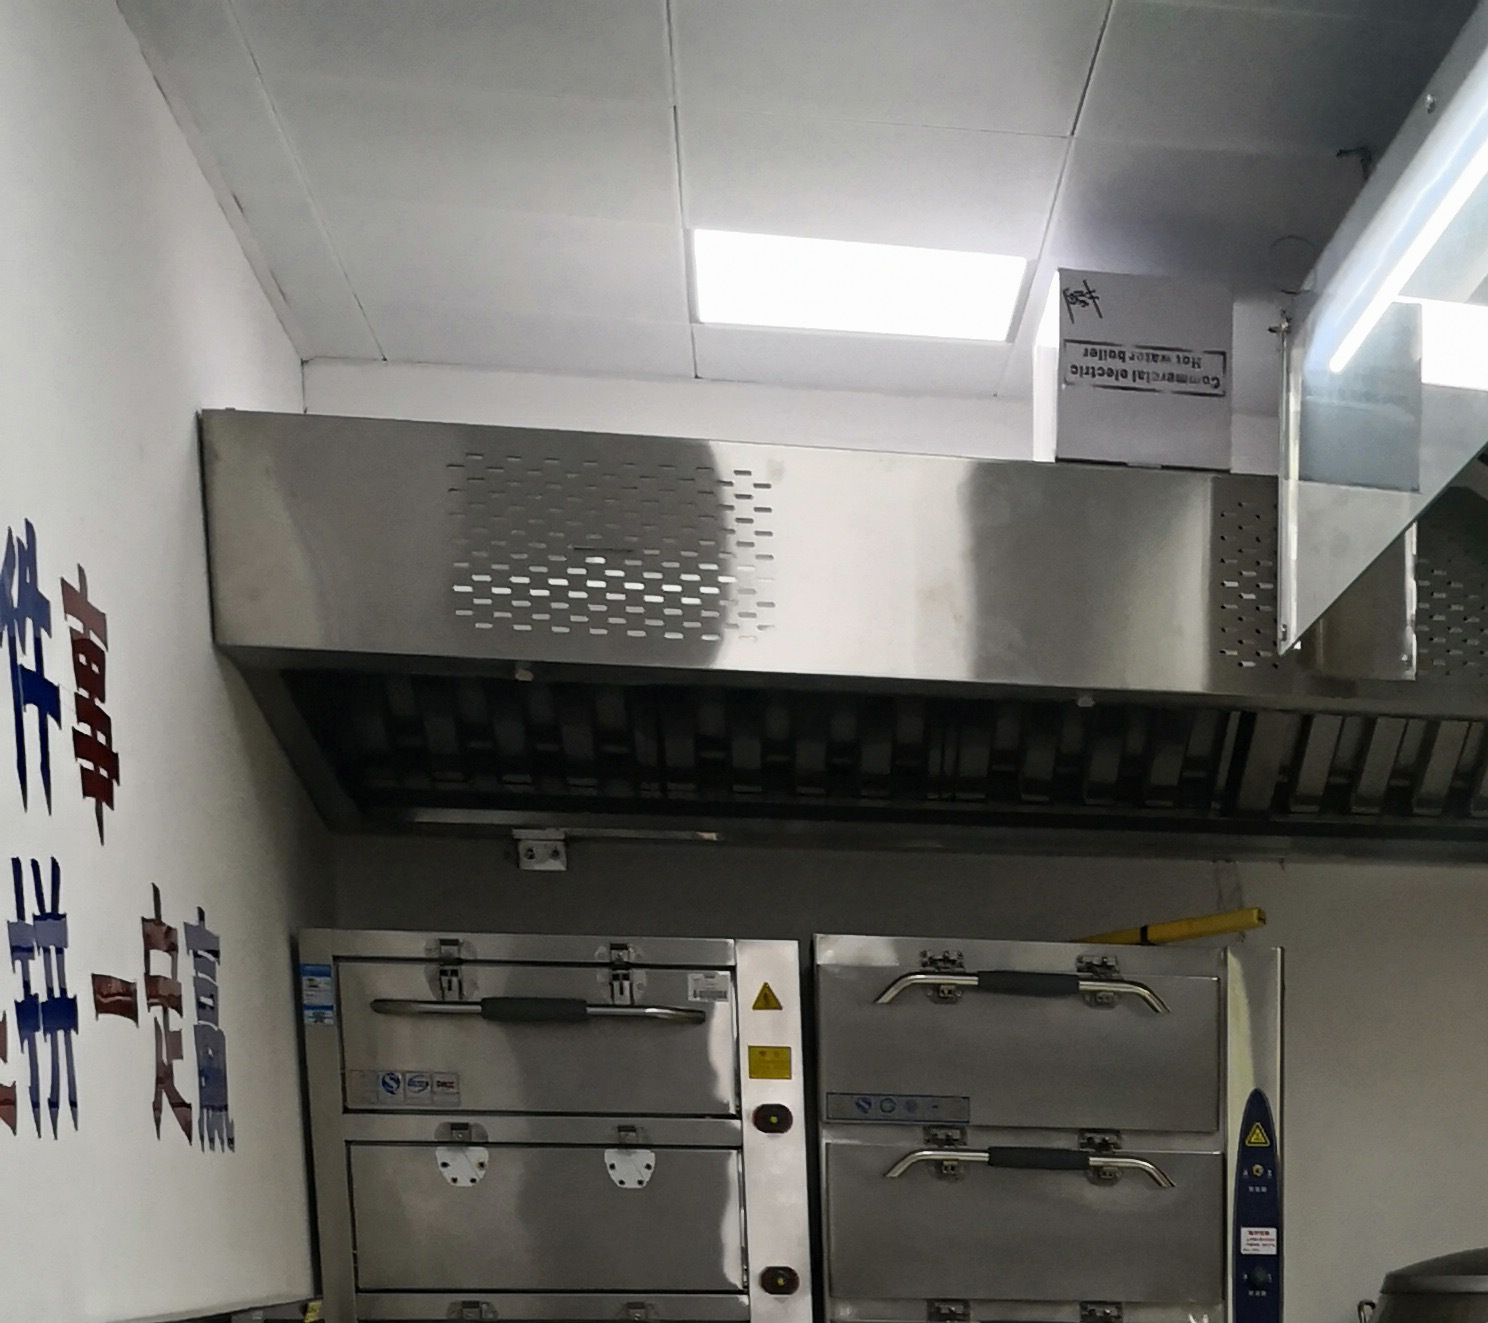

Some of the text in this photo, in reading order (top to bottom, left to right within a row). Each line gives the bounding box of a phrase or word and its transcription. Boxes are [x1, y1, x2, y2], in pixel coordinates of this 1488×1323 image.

[1129, 352, 1172, 367] water
[1069, 363, 1221, 389] Commercial electric
[0, 855, 235, 1153] 拼一定赢
